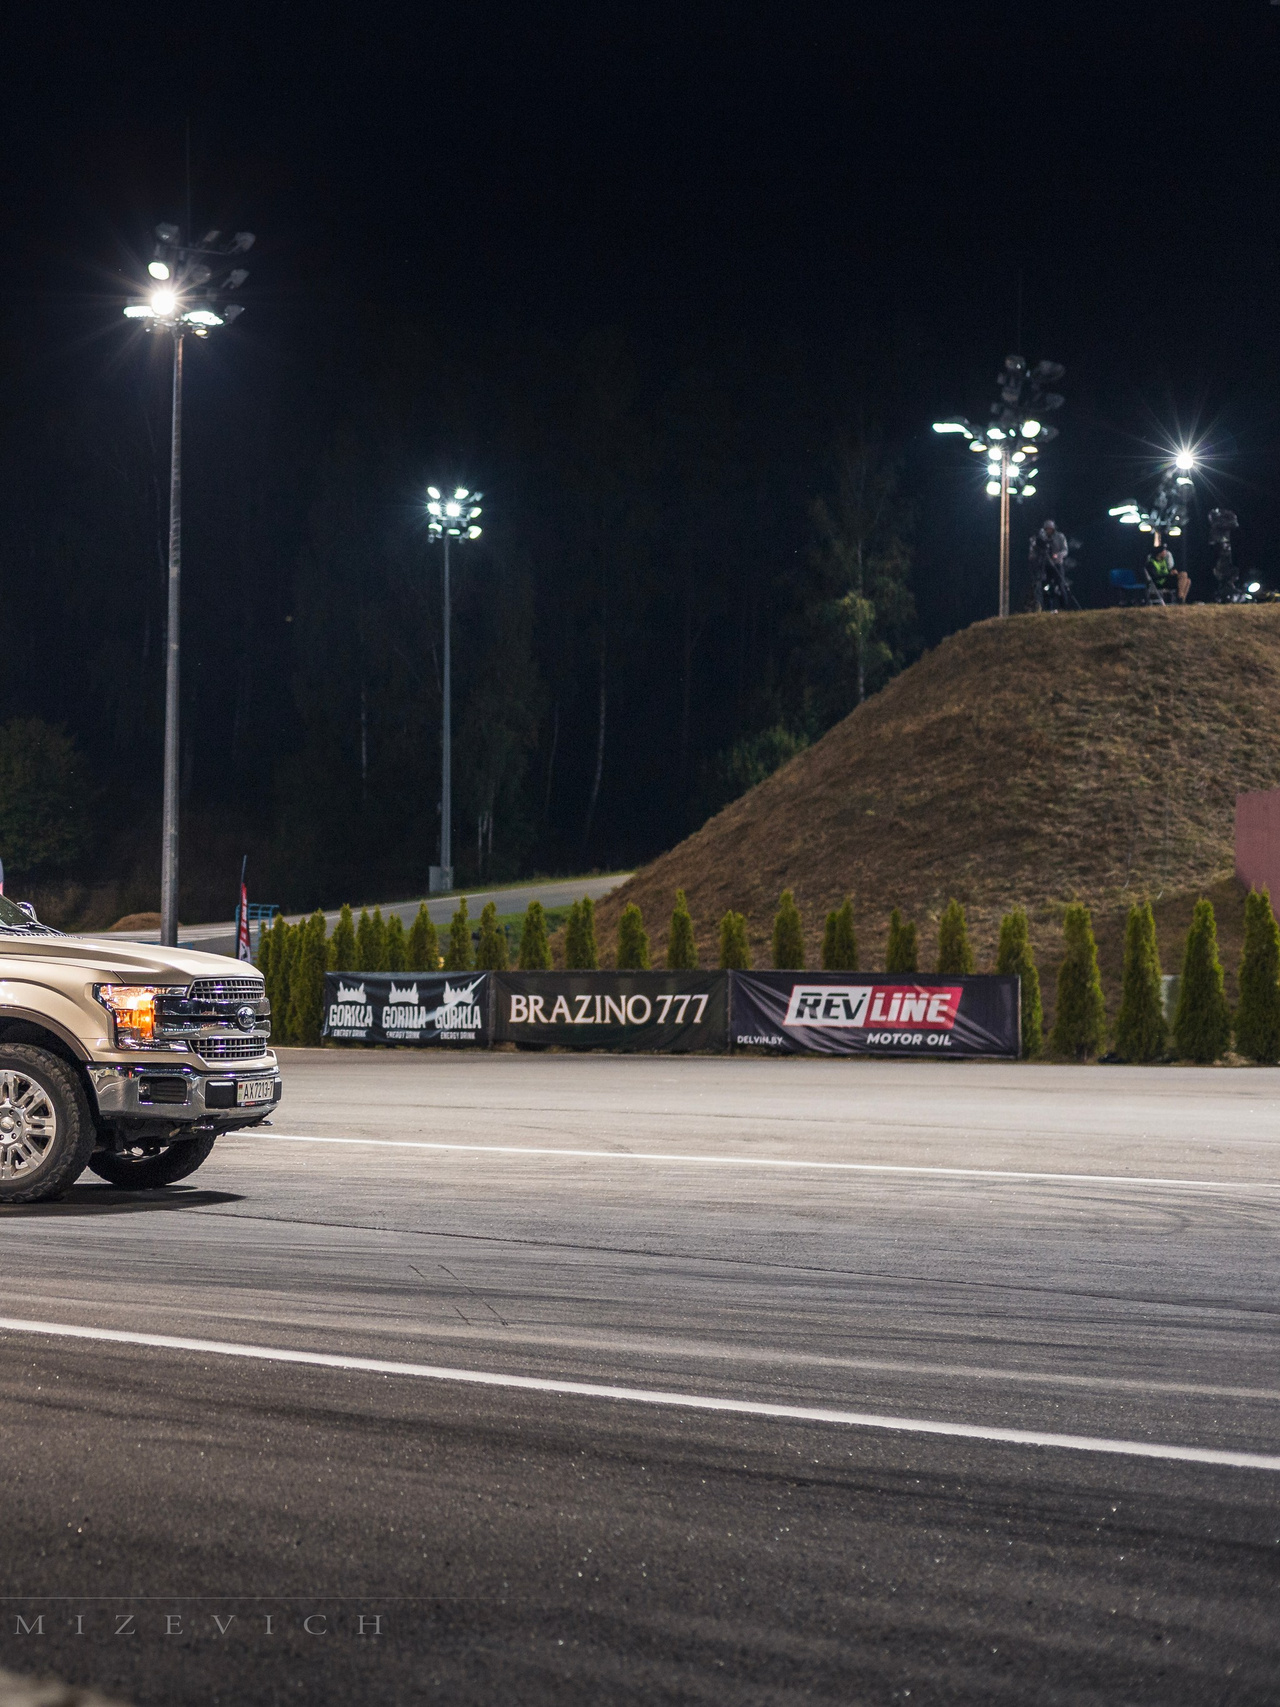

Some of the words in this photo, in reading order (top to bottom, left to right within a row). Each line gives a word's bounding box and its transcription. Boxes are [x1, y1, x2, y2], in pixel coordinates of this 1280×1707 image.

[329, 1004, 373, 1027] GORILLA
[382, 1006, 426, 1029] GORILLA
[435, 1006, 482, 1029] GORILLA
[333, 1029, 352, 1037] ENERGY
[352, 1030, 367, 1038] DRINK
[386, 1031, 406, 1039] ENERGY
[406, 1031, 420, 1039] DRINK
[440, 1031, 459, 1040] ENERGY
[460, 1031, 475, 1040] DRINK
[867, 1033, 922, 1045] MOTOR
[927, 1033, 952, 1046] OIL
